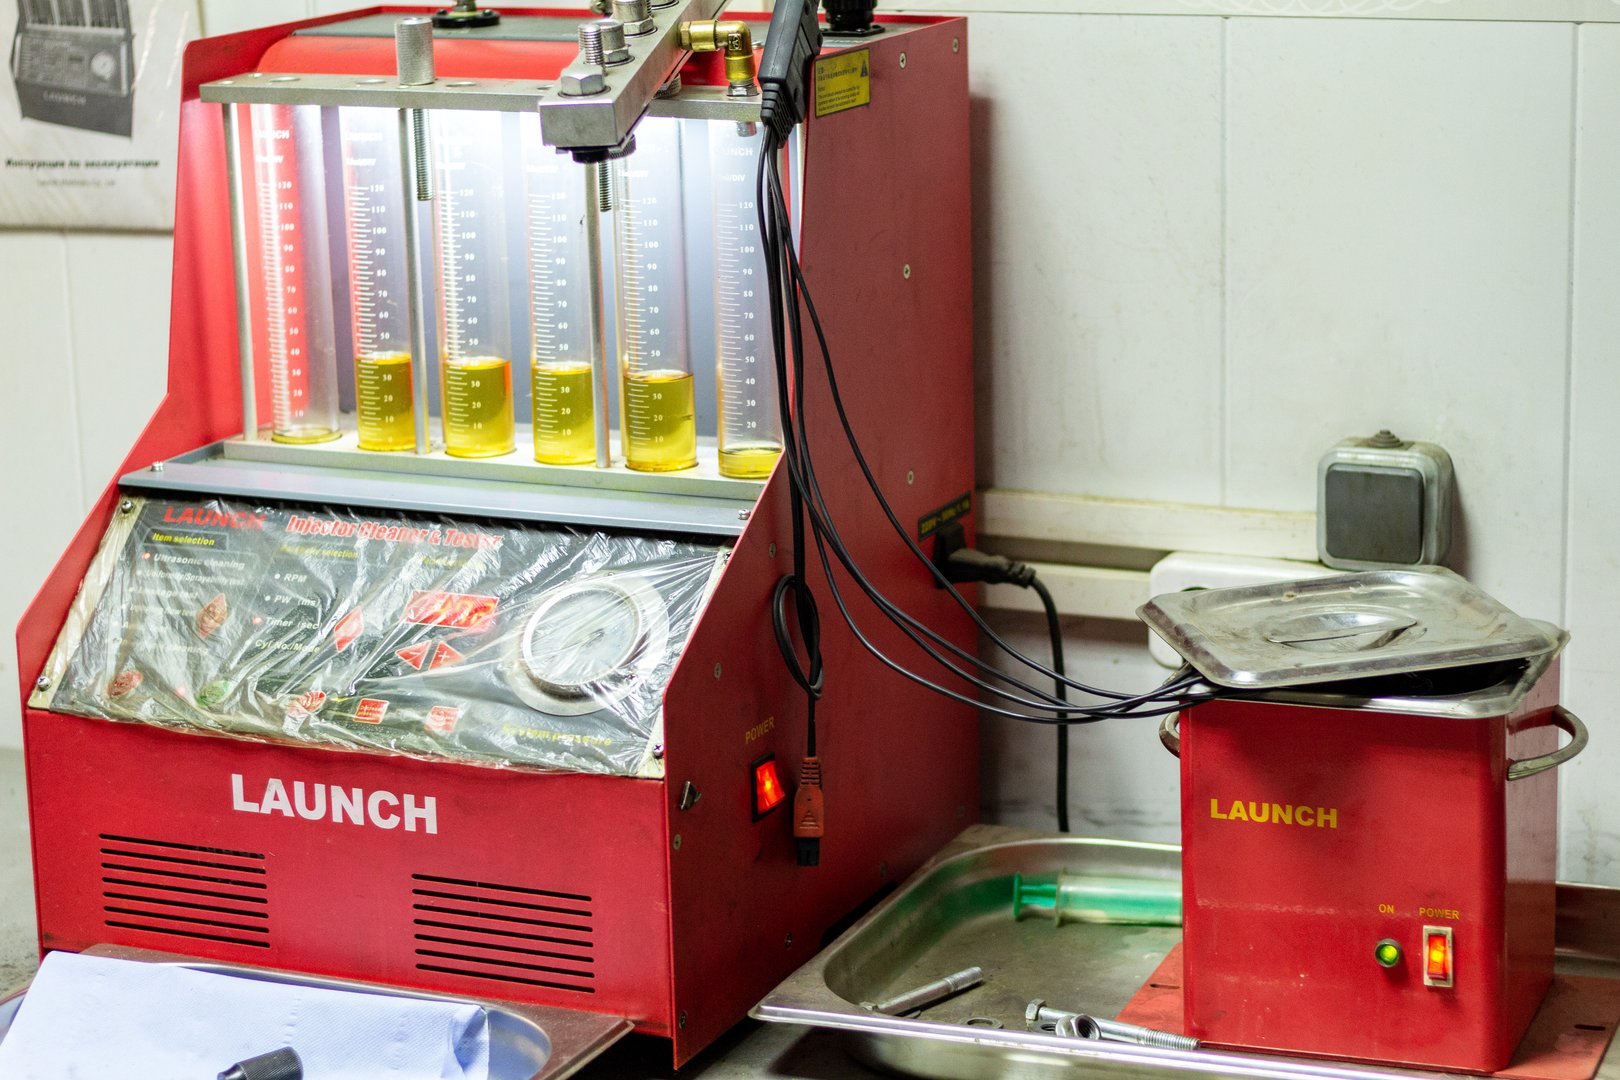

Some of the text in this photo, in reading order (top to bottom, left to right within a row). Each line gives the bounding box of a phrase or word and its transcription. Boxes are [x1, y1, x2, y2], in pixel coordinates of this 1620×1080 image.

[644, 241, 659, 249] 100
[375, 248, 386, 256] 90
[464, 253, 475, 261] 90
[650, 328, 660, 336] 60
[747, 421, 756, 429] 20
[162, 506, 267, 531] LAUNCH
[287, 514, 359, 538] Injector
[443, 528, 505, 550] Tesr
[152, 533, 215, 546] Item selection
[154, 553, 245, 570] Ultrasonic cleaning
[284, 573, 307, 583] RPM
[274, 594, 320, 607] PW (ms)
[265, 616, 293, 627] Timer
[275, 641, 320, 653] No./Me
[745, 716, 775, 745] POWER
[231, 773, 438, 835] LAUNCH
[1210, 798, 1338, 829] LAUNCH
[1378, 903, 1395, 914] ON
[1419, 907, 1460, 920] POWER
